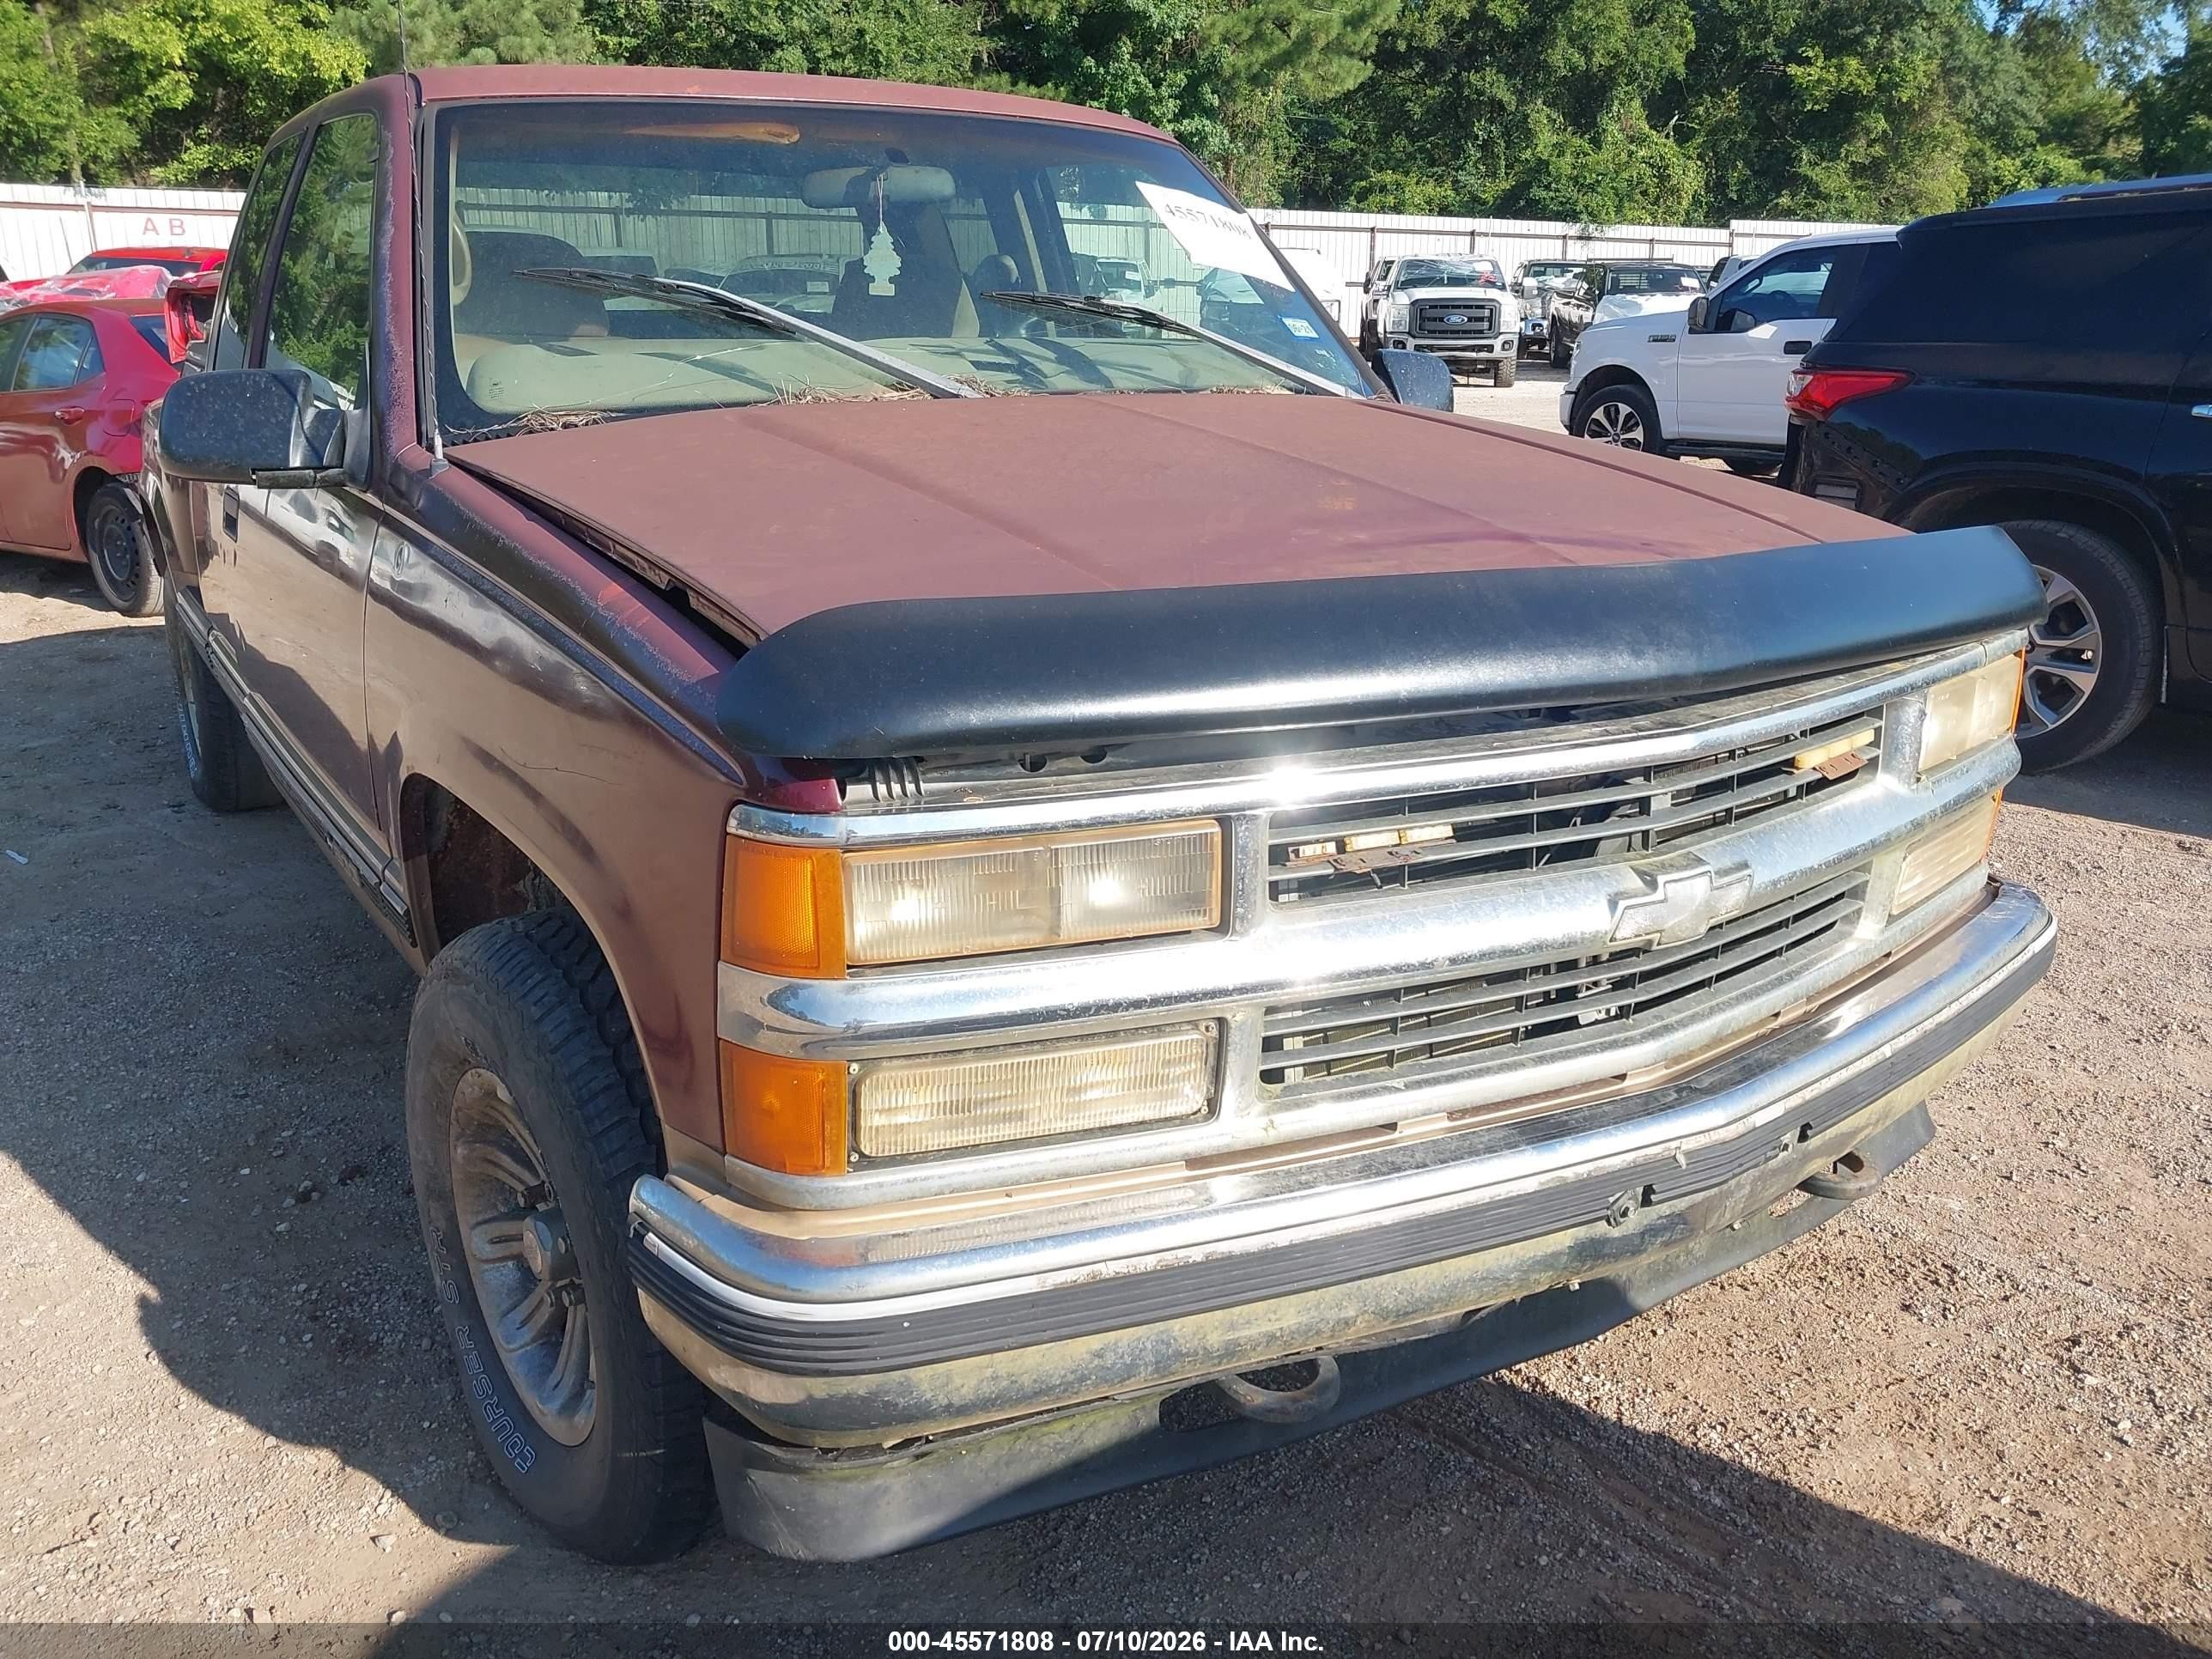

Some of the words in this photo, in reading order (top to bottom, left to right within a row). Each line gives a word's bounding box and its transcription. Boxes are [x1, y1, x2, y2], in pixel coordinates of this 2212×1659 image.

[143, 217, 160, 236] A
[169, 218, 186, 236] B
[430, 1227, 459, 1305] STR
[455, 1325, 536, 1474] COURSER
